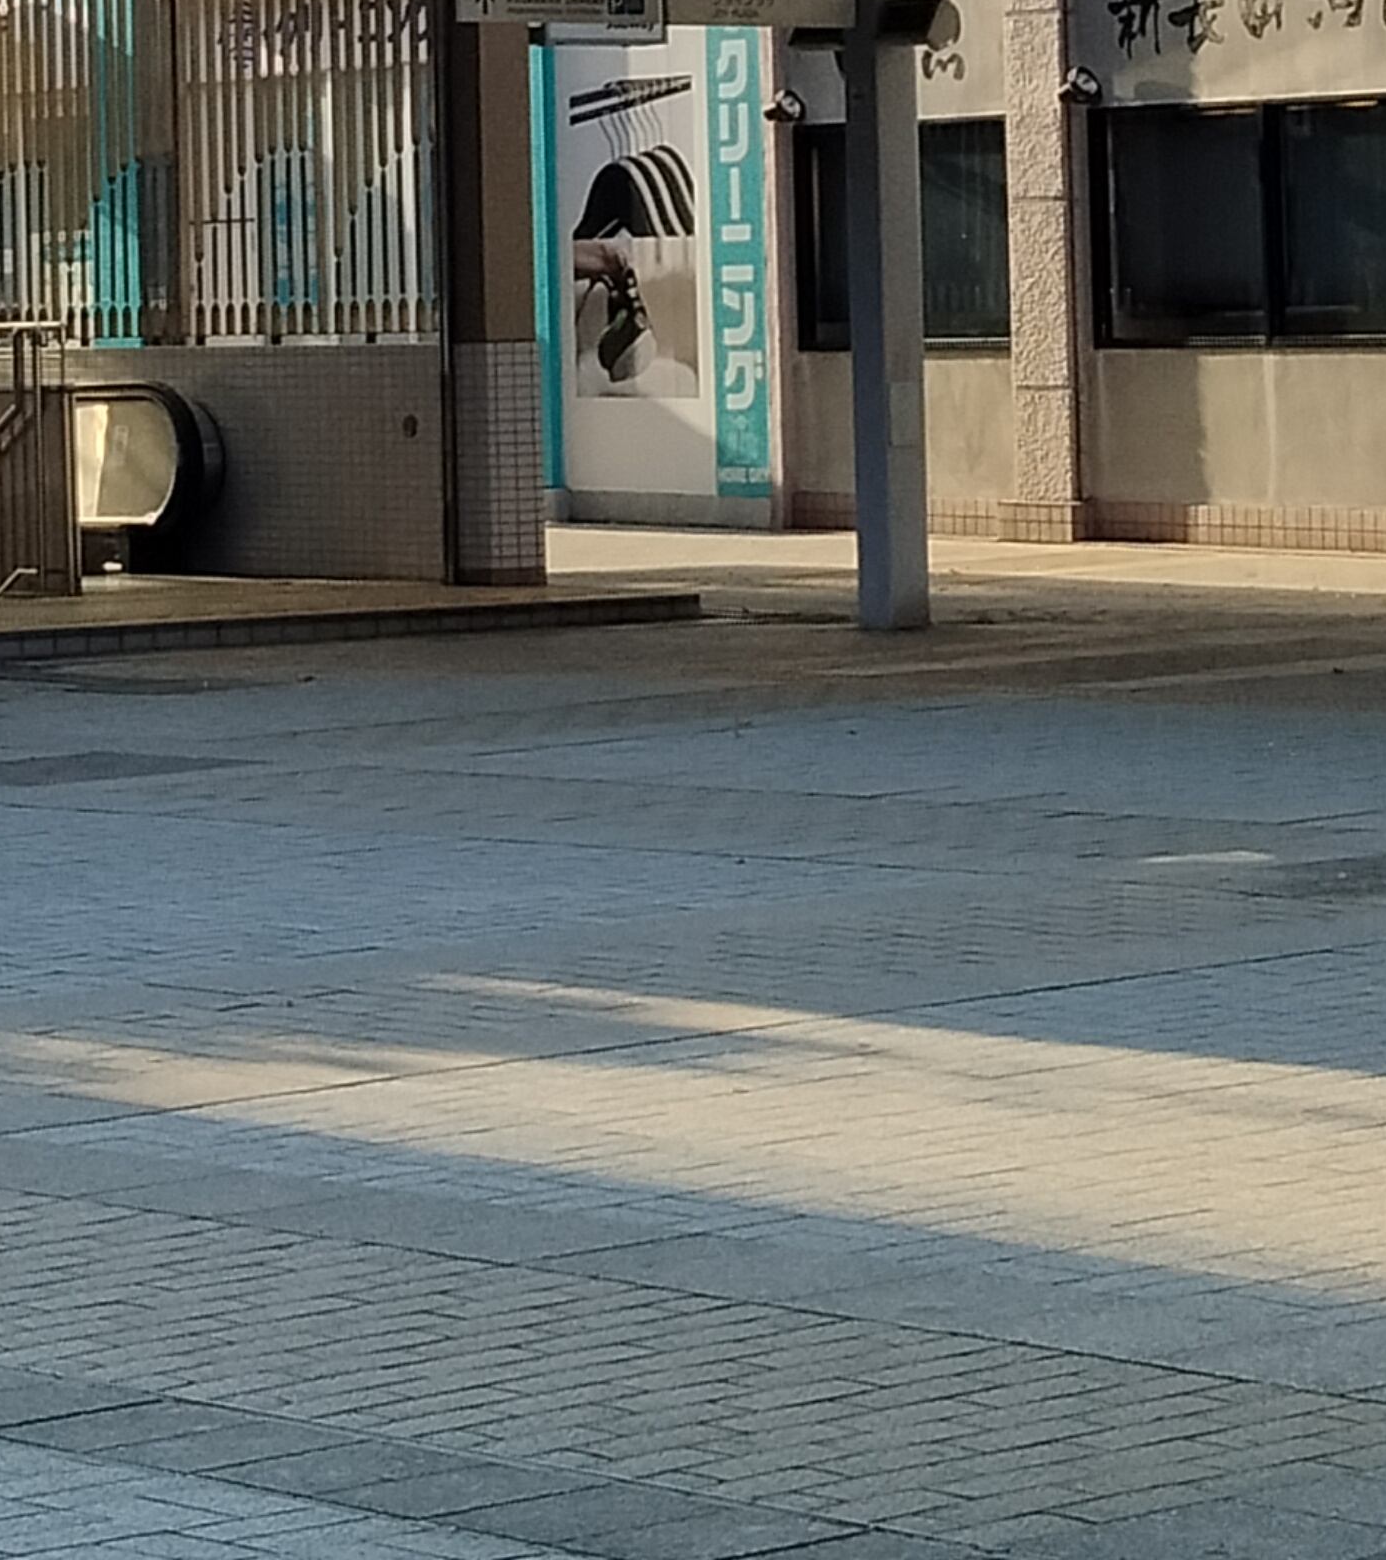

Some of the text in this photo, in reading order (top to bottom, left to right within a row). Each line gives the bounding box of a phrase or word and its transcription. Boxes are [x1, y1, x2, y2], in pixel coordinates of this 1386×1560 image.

[717, 38, 765, 411] クリーニング
